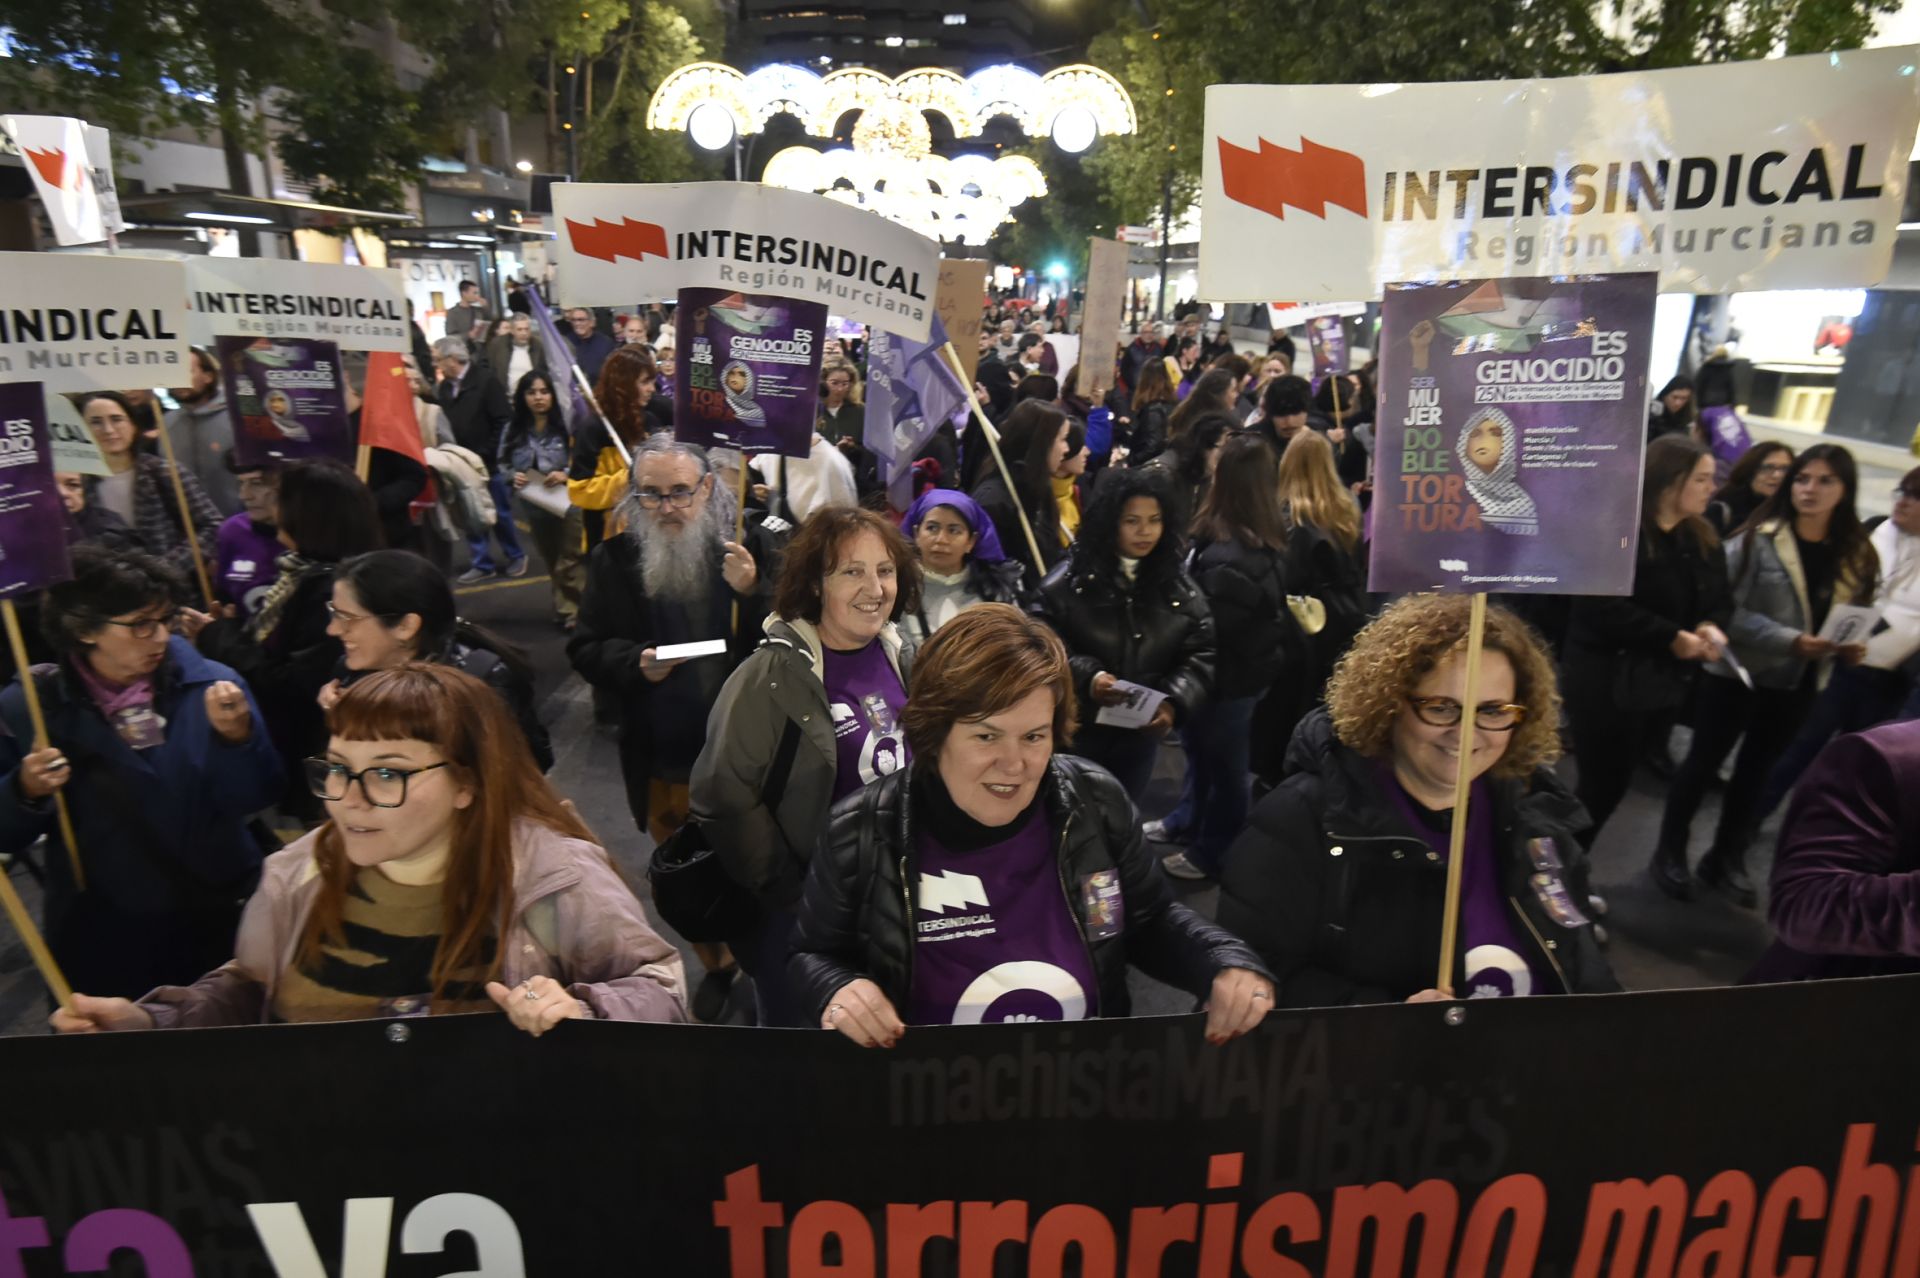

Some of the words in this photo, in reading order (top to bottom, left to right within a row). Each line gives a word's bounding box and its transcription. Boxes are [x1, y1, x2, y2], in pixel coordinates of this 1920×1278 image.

[1382, 143, 1883, 222] INTERSINDICAL
[1455, 222, 1608, 266] Región
[1633, 215, 1876, 256] Murciana
[676, 229, 927, 300] INTERSINDICAL
[720, 264, 804, 289] Región
[816, 275, 924, 322] Murciana
[195, 291, 402, 321] INTERSINDICAL
[238, 319, 308, 334] Región
[315, 321, 404, 338] Murciana
[793, 328, 813, 342] ES
[730, 336, 812, 355] GENOCIDIO
[1591, 330, 1629, 356] ES
[28, 347, 179, 370] Murciana
[1475, 356, 1626, 384] GENOCIDIO
[1410, 376, 1436, 388] SER
[1408, 388, 1440, 408] MU
[5, 419, 34, 436] ES
[1403, 407, 1443, 426] JER
[1403, 428, 1442, 450] DO
[1402, 451, 1450, 473] BLE
[1400, 474, 1465, 504] TOR
[1398, 503, 1484, 532] TURA
[714, 1152, 1548, 1278] terrorismo
